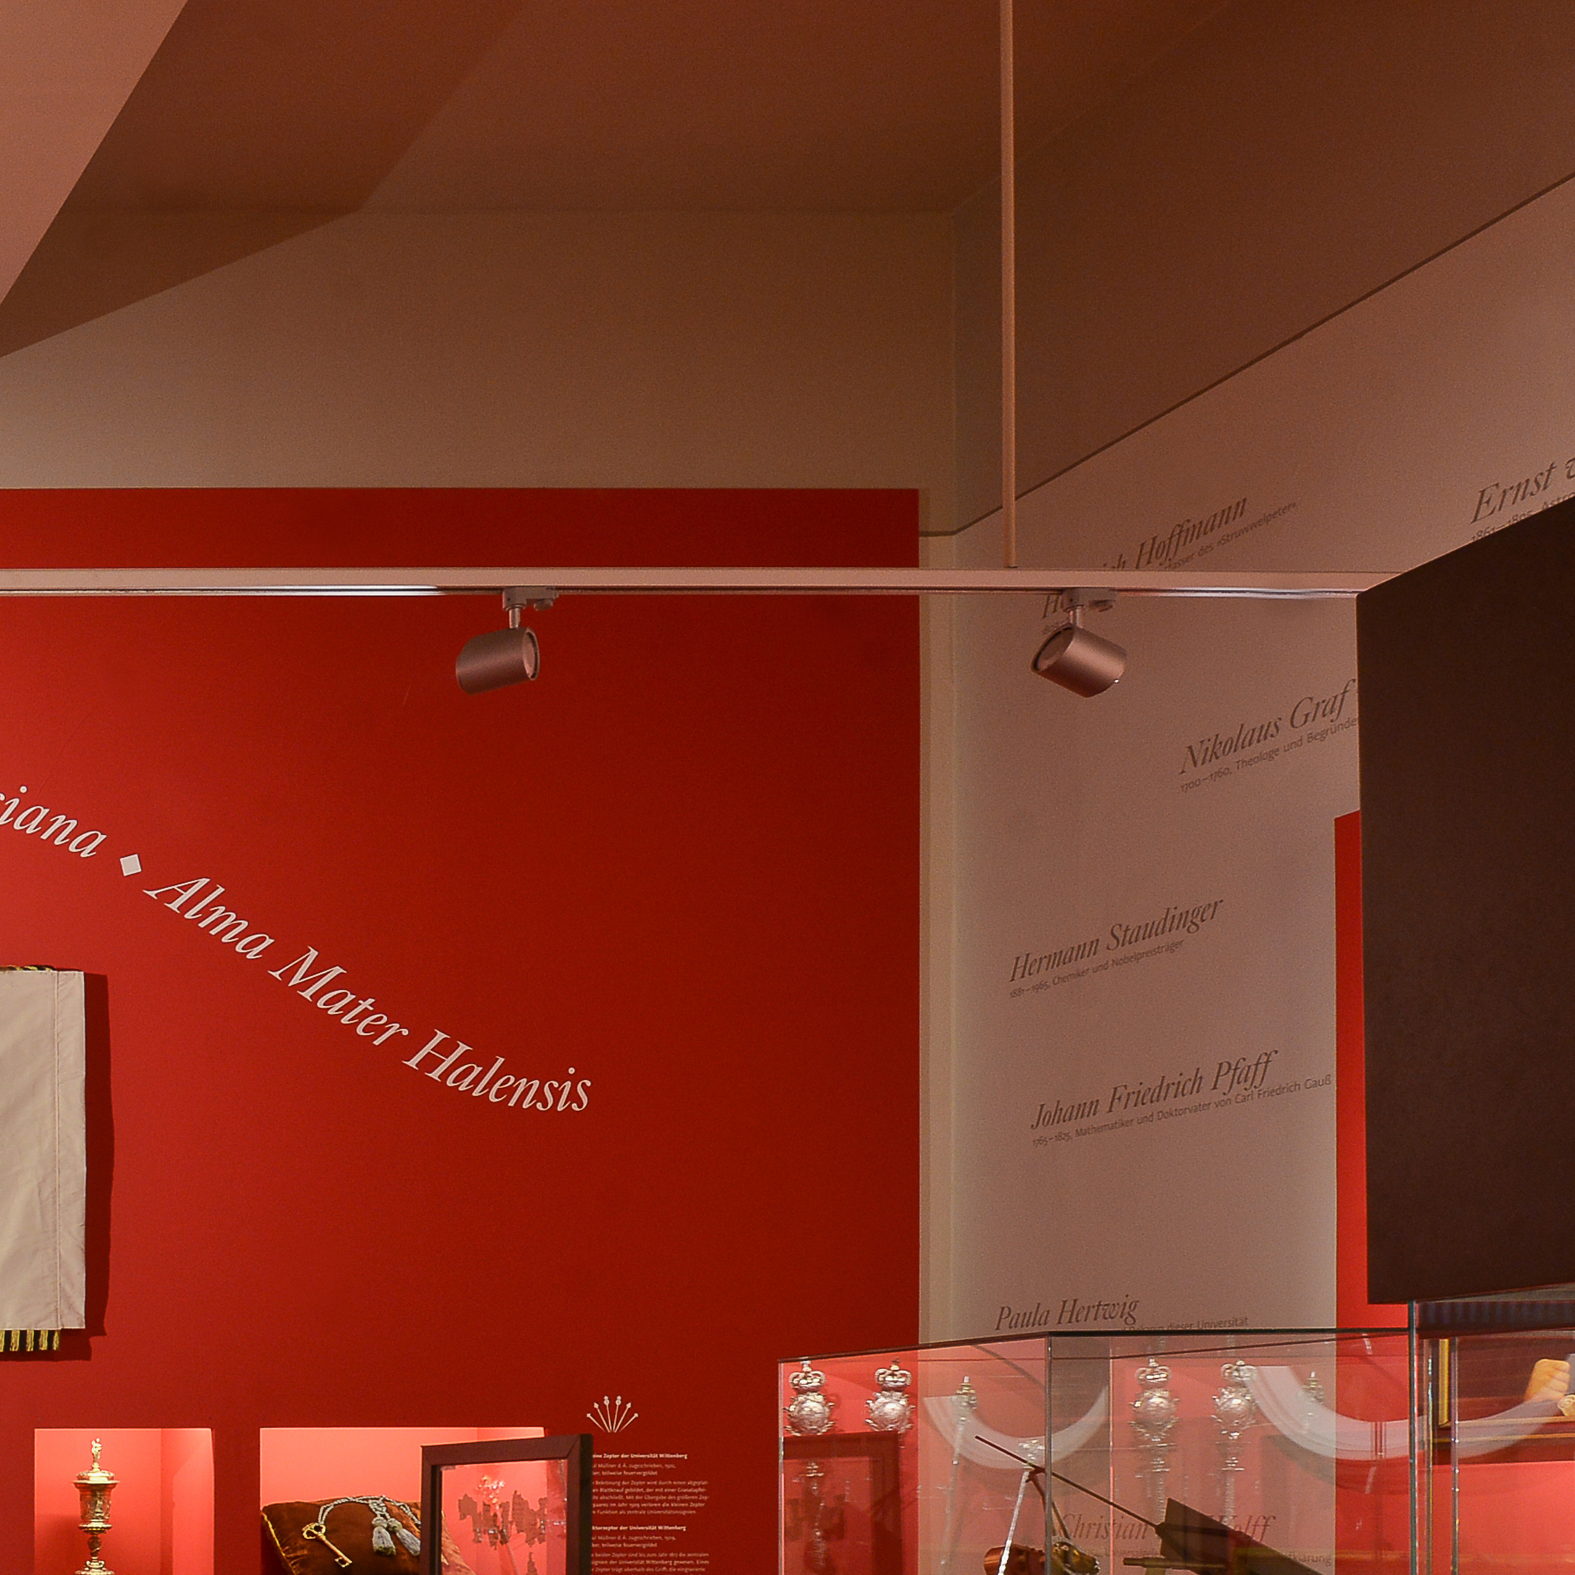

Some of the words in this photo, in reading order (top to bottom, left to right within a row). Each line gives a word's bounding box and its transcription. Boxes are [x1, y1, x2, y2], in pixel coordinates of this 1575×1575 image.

[1470, 462, 1557, 524] Ernst
[1134, 497, 1247, 569] Hoffmann
[1179, 717, 1282, 775] Nikolaus
[1289, 678, 1356, 729] Graf
[1236, 747, 1279, 771] Theologe
[1283, 735, 1303, 752] und
[1009, 938, 1100, 982] Hermann
[1106, 899, 1224, 951] Staudinger
[1052, 967, 1090, 986] Chemiker
[1091, 962, 1109, 974] und
[1111, 938, 1185, 968] Nobelpreisträger
[143, 876, 275, 959] Alma
[267, 946, 408, 1046] Mater
[402, 1028, 592, 1112] Halensis
[1031, 1098, 1100, 1130] Johann
[1106, 1066, 1203, 1113] Friedrich
[1210, 1049, 1278, 1097] Pfaff
[1074, 1116, 1135, 1139] Mathematiker
[1136, 1111, 1155, 1126] und
[1157, 1101, 1211, 1122] Doktorvater
[1213, 1097, 1232, 1110] von
[1234, 1090, 1255, 1105] Carl
[1257, 1081, 1302, 1100] Friedrich
[1303, 1074, 1332, 1090] Gauß
[995, 1302, 1051, 1331] Paula
[1056, 1294, 1140, 1326] Hertwig
[1197, 1317, 1248, 1329] Universität
